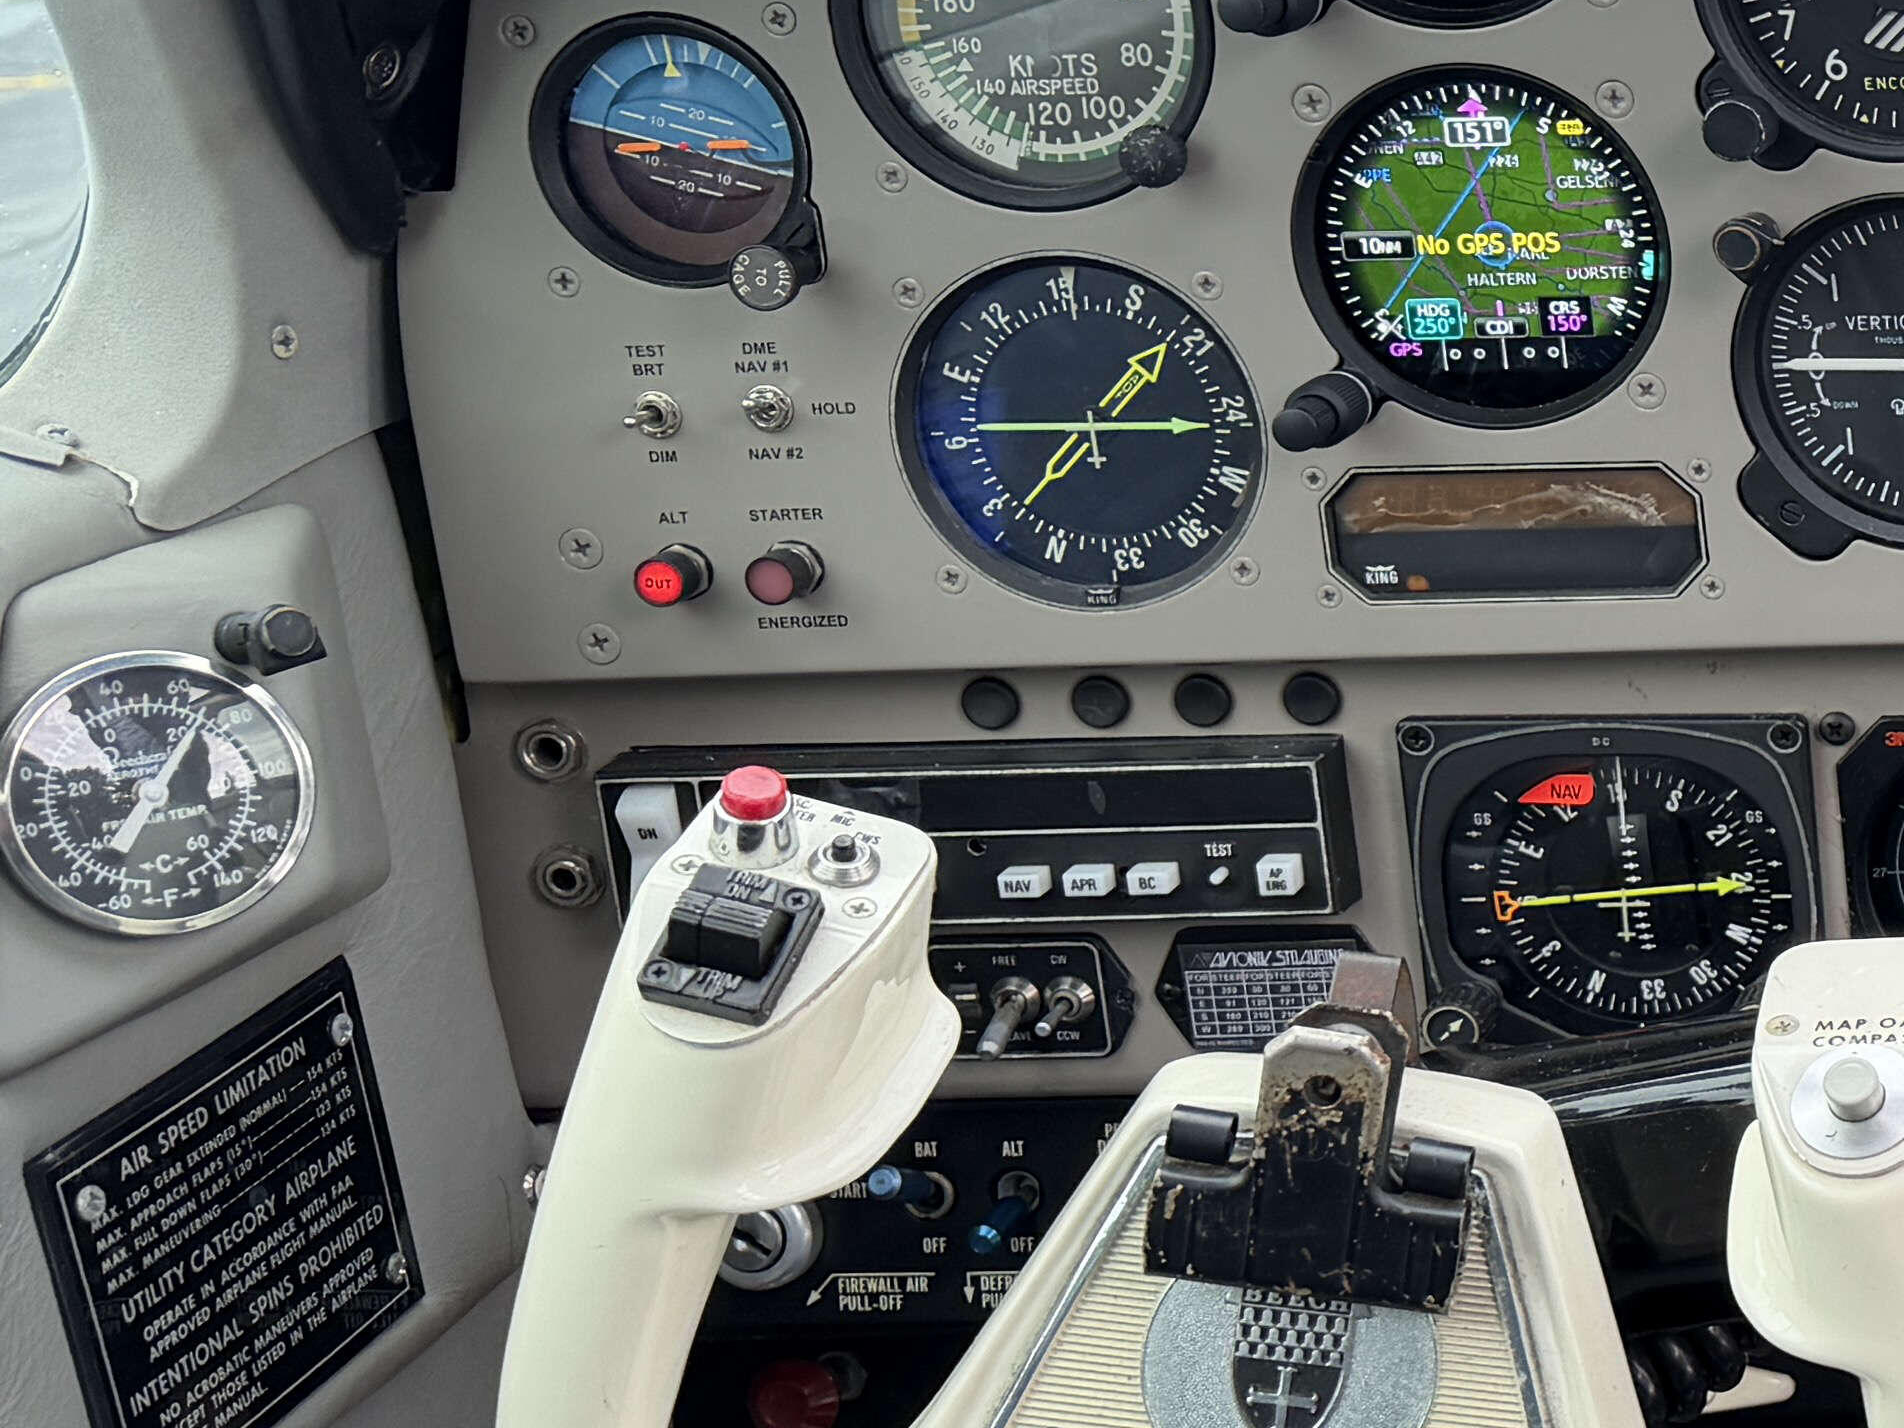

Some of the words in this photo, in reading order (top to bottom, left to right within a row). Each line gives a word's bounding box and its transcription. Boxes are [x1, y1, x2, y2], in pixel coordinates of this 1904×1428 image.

[1009, 76, 1099, 96] AIRSPEED
[1451, 119, 1502, 143] 151°
[1416, 234, 1451, 256] No
[1457, 233, 1505, 257] GPS
[1512, 232, 1561, 255] POS
[1466, 272, 1538, 288] HALTERN
[624, 344, 666, 358] TEST
[741, 341, 778, 355] DME
[632, 362, 665, 376] BRT
[734, 360, 767, 373] NAV
[771, 360, 790, 373] #1
[811, 401, 856, 416] HOLD
[648, 450, 679, 463] DIM
[748, 448, 781, 461] NAV
[784, 446, 804, 460] #2
[659, 511, 688, 524] ALT
[749, 507, 824, 523] STARTER
[644, 576, 672, 590] OUT
[758, 614, 848, 630] ENERGIZED
[1004, 878, 1032, 893] NAV
[1070, 877, 1098, 892] APR
[1815, 1018, 1867, 1031] MAP
[120, 1145, 151, 1181] AIR
[158, 1106, 209, 1156] SPEED
[214, 1036, 307, 1110] LIMITATION
[122, 1266, 187, 1323] UTILITY
[192, 1194, 277, 1275] CATEGORY
[283, 1135, 359, 1206] AIRPLANE
[838, 1277, 899, 1293] FIREWALL
[904, 1276, 928, 1292] AIR
[838, 1293, 904, 1311] PULL-OFF
[130, 1320, 245, 1417] INTENTIONAL
[249, 1275, 295, 1324] SPINS
[299, 1205, 384, 1282] PROHIBITED
